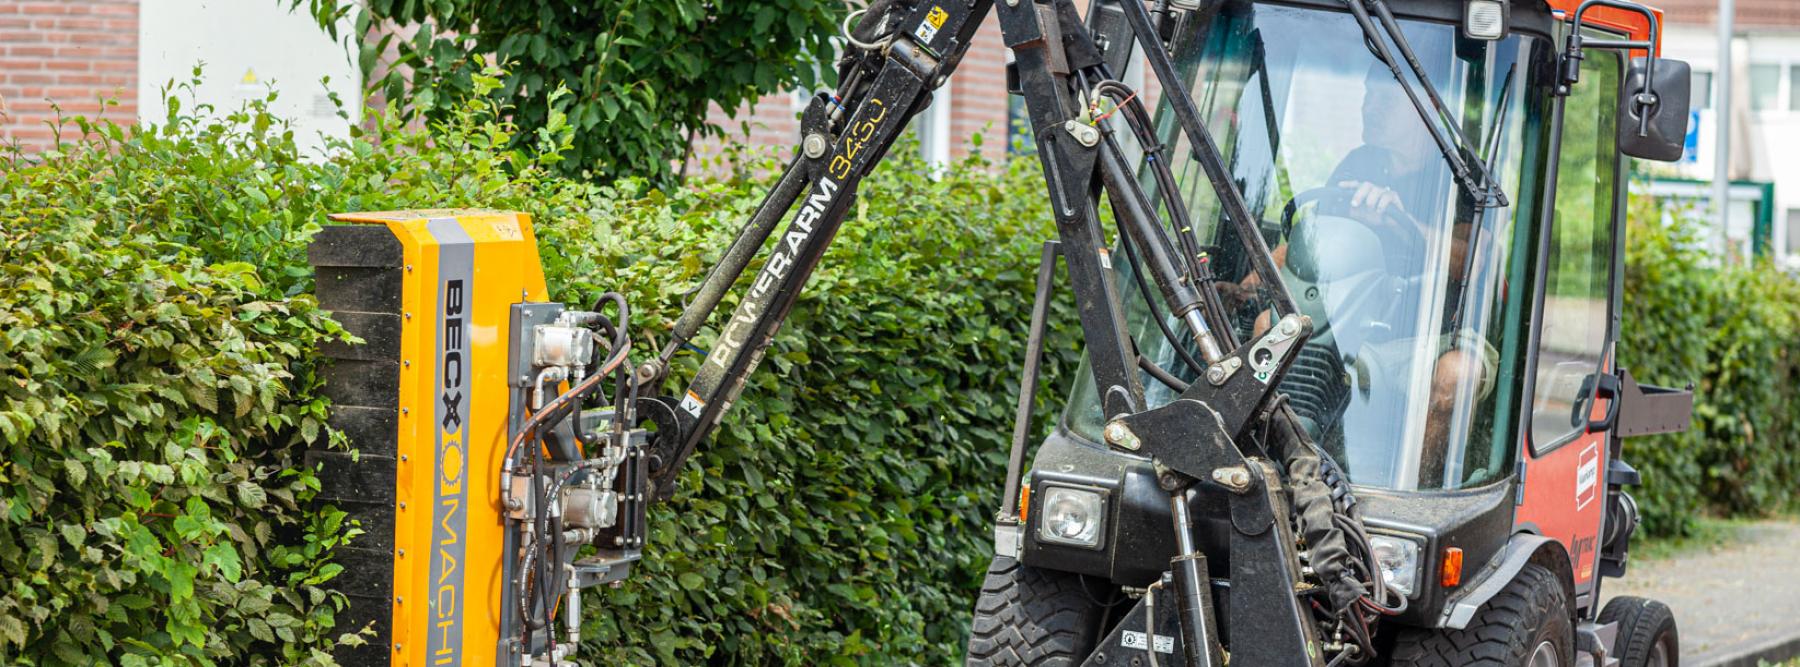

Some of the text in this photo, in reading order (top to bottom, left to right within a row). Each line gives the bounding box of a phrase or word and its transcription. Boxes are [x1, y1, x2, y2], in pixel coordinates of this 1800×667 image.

[711, 98, 887, 369] POWERARM 3450
[435, 279, 463, 666] BECX MACHI
